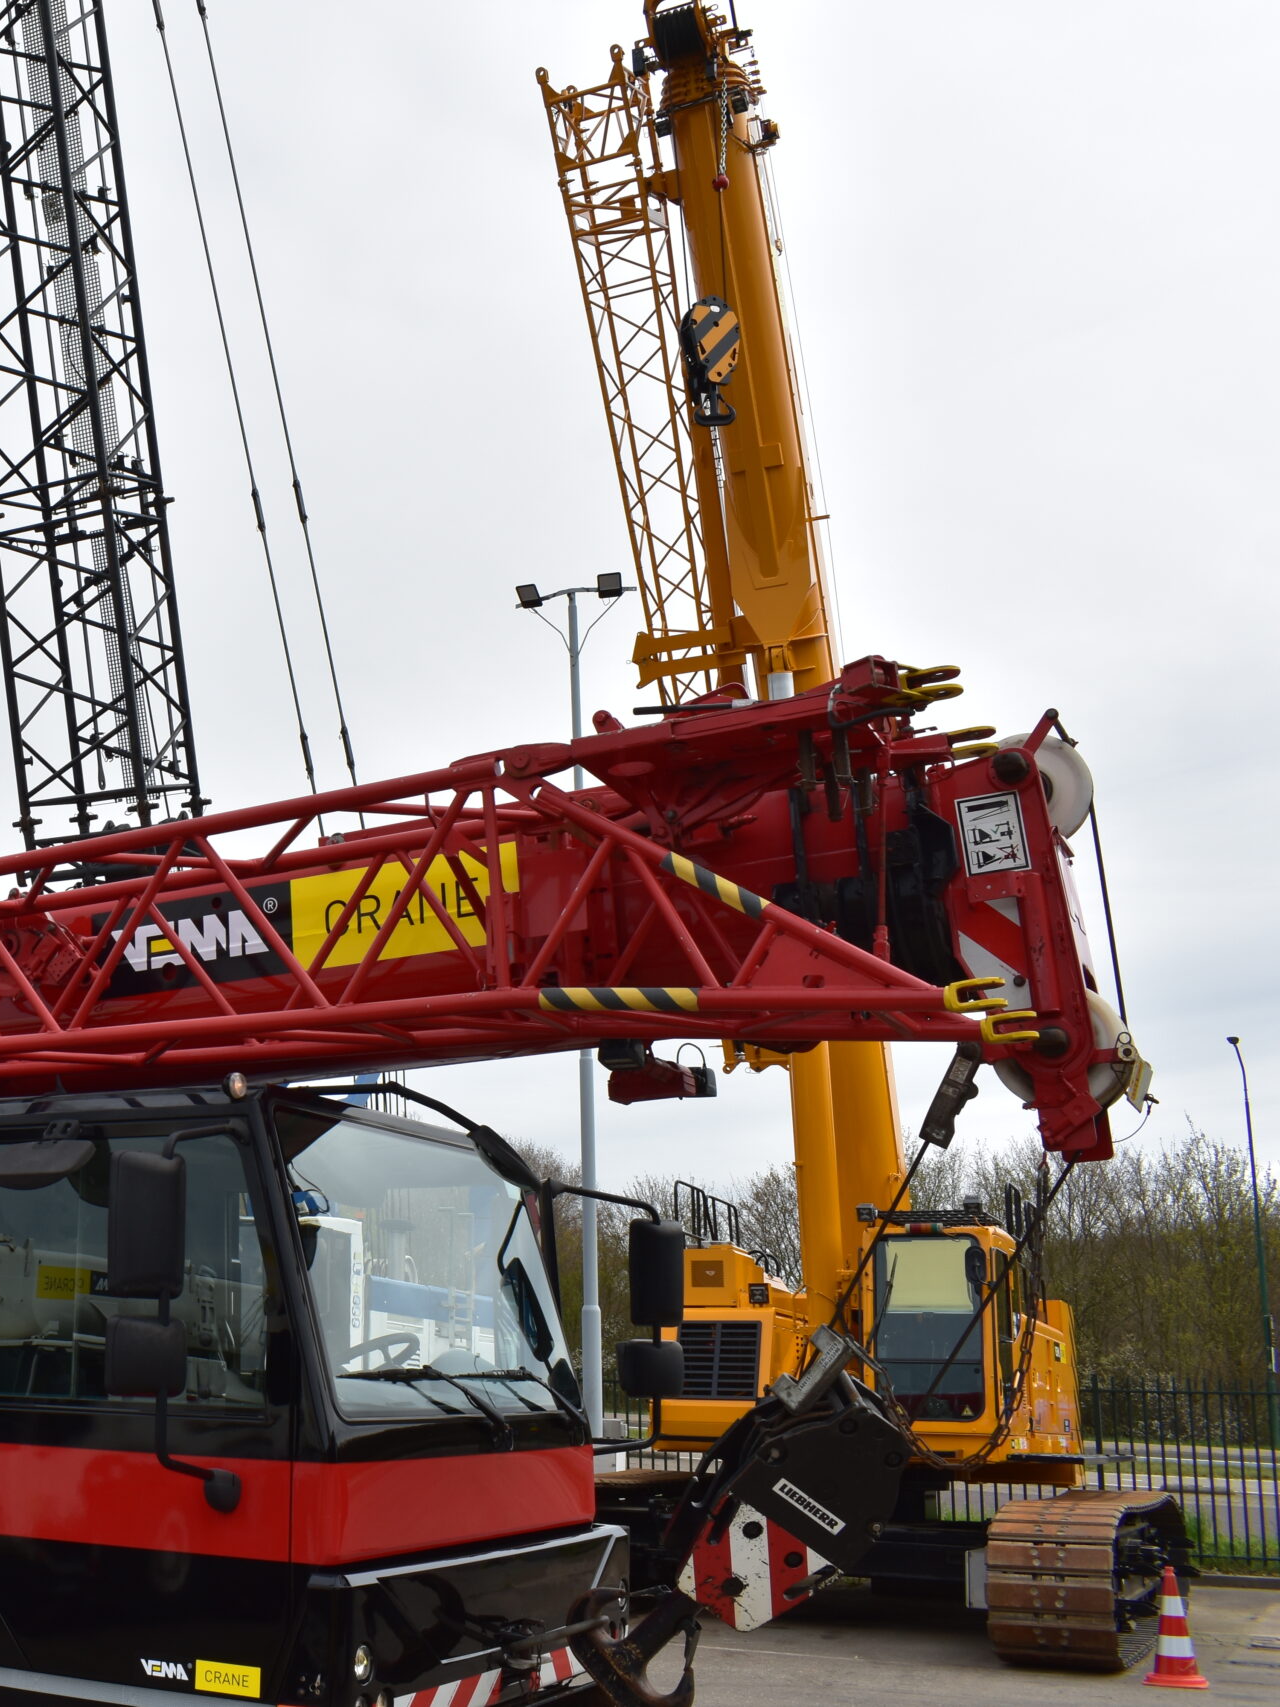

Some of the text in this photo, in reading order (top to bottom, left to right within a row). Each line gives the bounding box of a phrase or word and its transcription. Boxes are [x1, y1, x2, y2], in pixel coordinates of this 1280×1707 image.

[778, 1483, 839, 1529] LIEBHERR
[140, 1658, 249, 1688] VEMA CRANE
